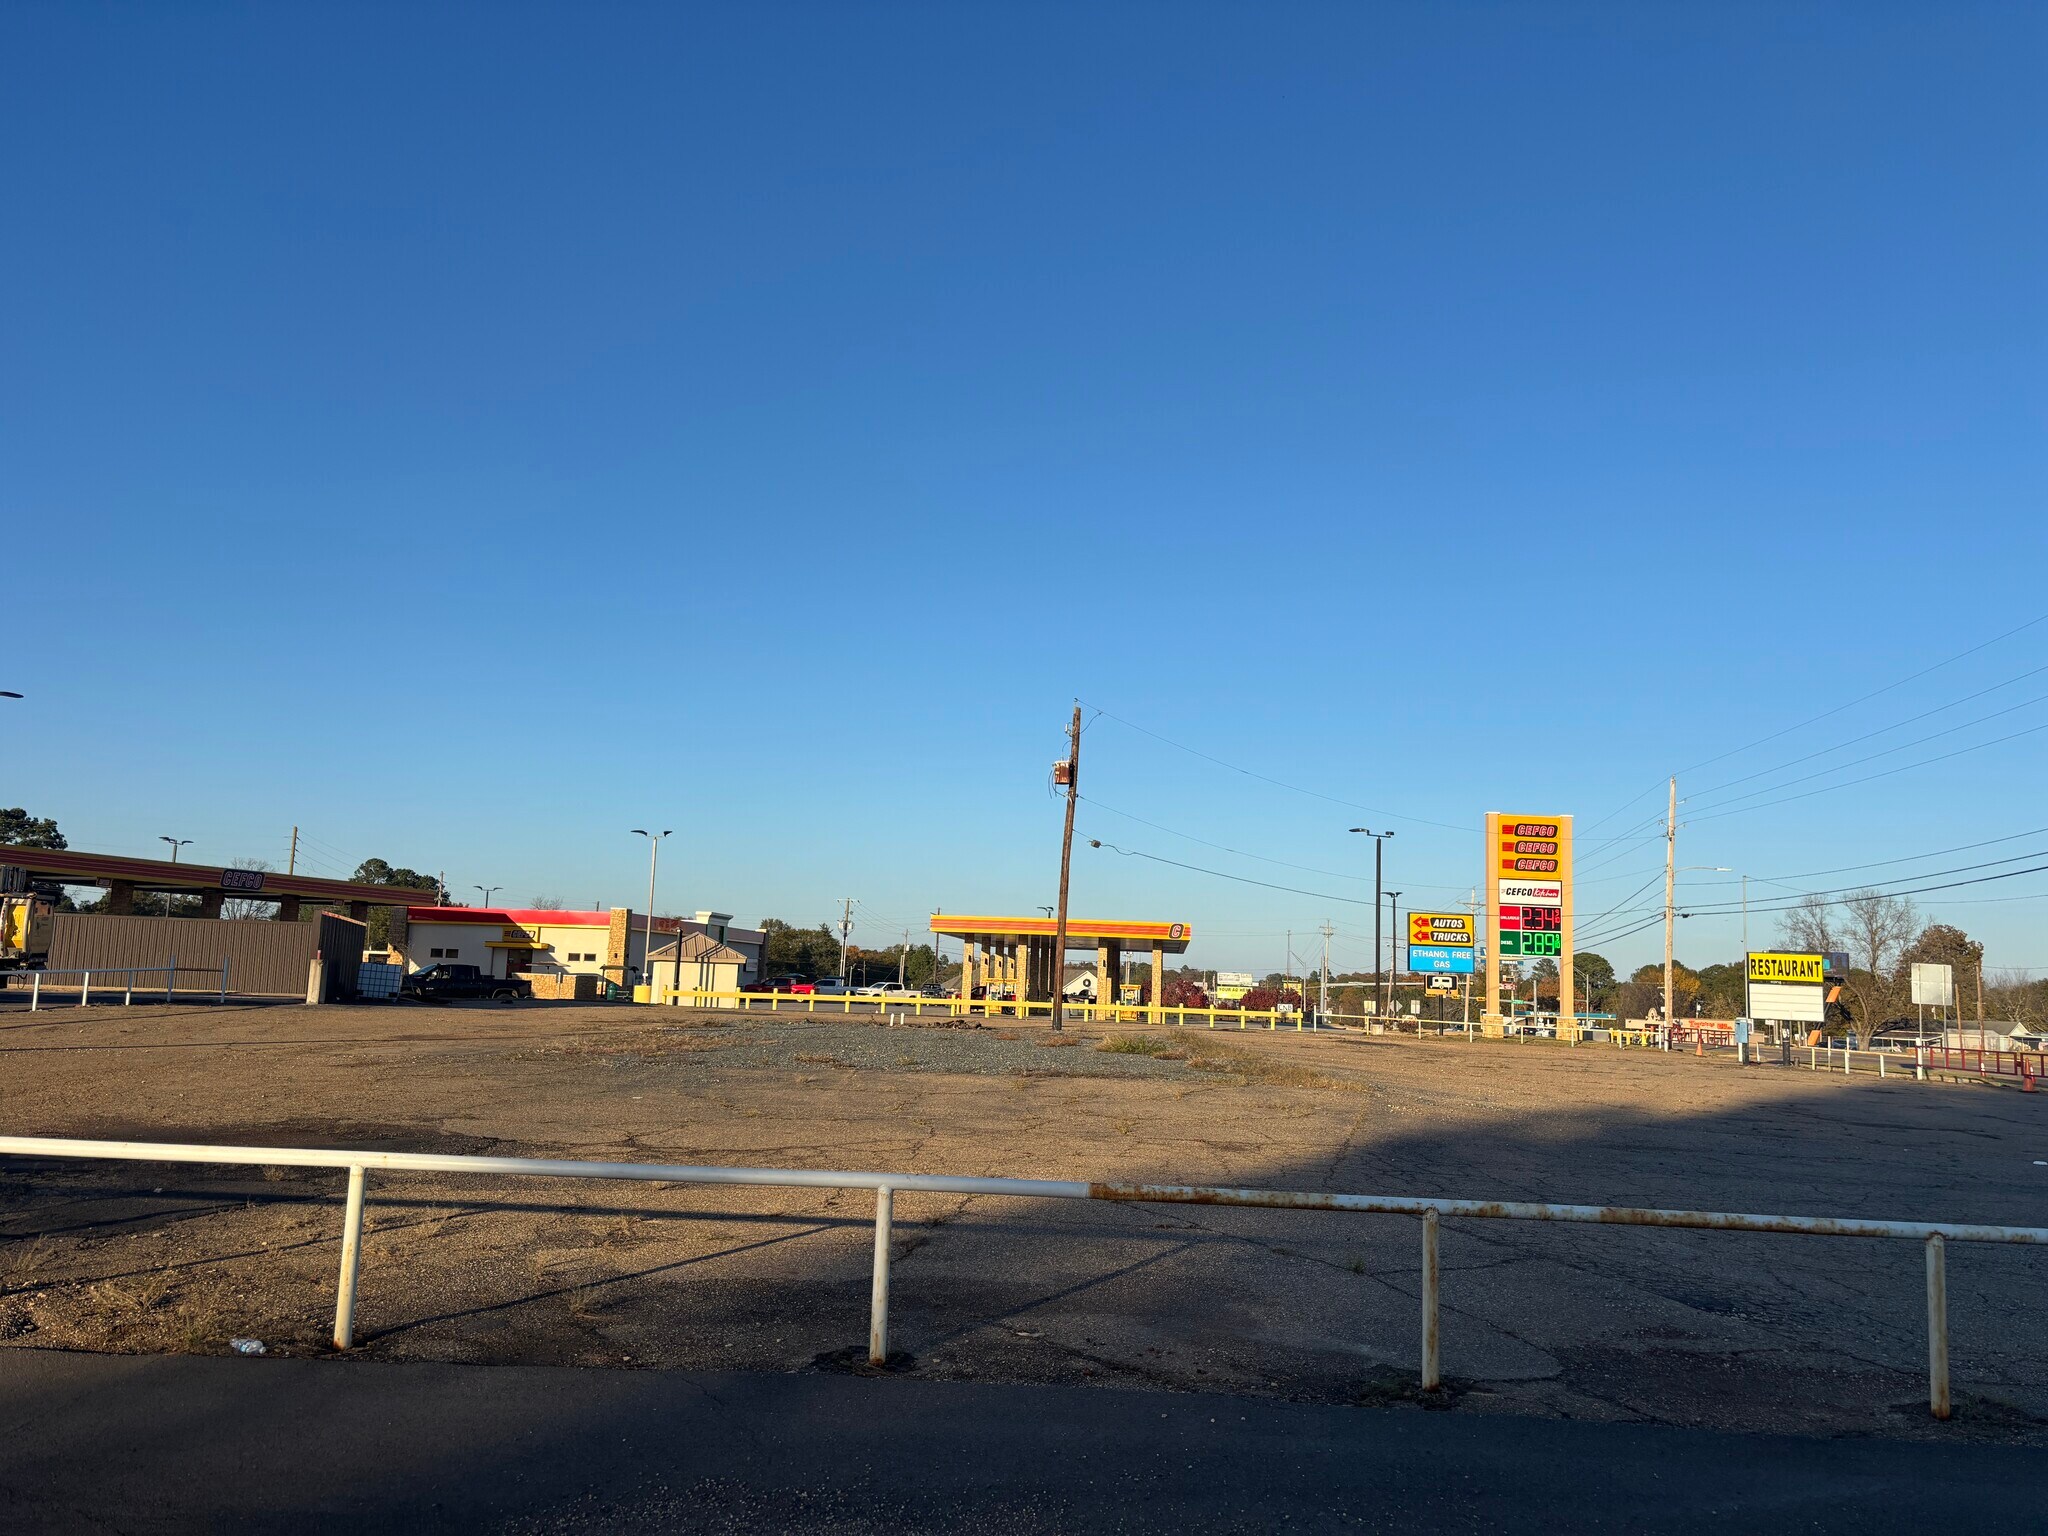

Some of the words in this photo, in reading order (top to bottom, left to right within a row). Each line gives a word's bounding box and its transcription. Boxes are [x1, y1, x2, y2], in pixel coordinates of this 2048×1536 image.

[1517, 825, 1555, 837] CEFCO
[1517, 842, 1555, 854] CEFCO
[1517, 859, 1555, 871] CEFCO
[223, 871, 263, 889] CEFCO
[1506, 887, 1533, 896] CEFCO
[1433, 919, 1463, 928] AUTOS
[1523, 908, 1554, 929] 2.34
[1433, 933, 1469, 942] TRUCKS
[1523, 933, 1554, 954] 2.89
[1412, 950, 1449, 958] ETHANOL
[1751, 959, 1820, 977] RESTAURANT
